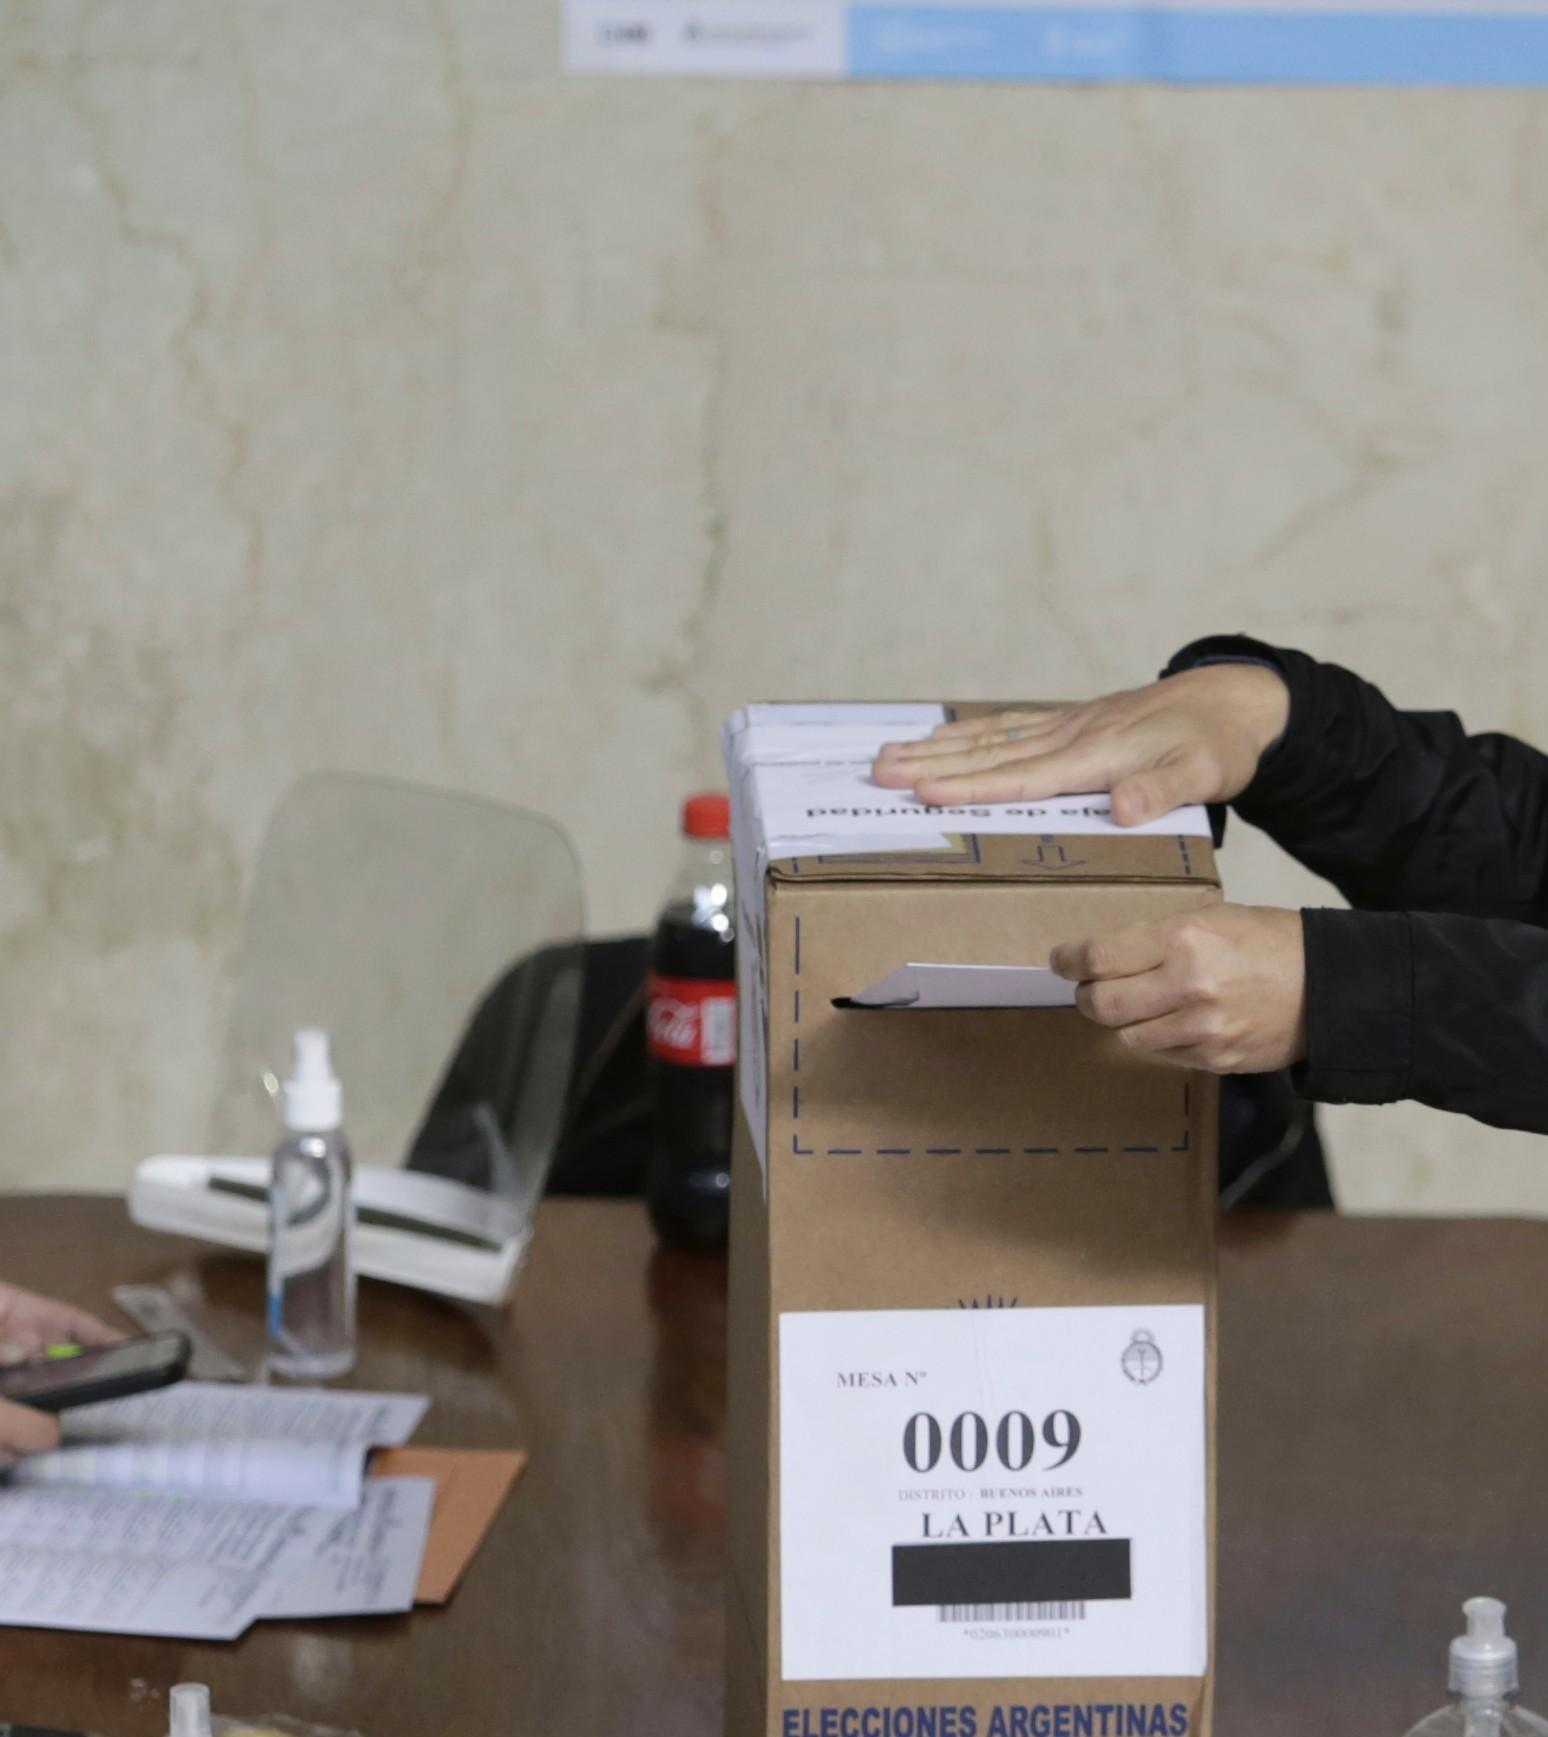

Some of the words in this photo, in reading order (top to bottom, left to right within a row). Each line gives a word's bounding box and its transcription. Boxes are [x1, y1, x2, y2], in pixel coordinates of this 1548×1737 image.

[807, 805, 991, 818] Seguridad
[1005, 807, 1047, 817] de
[1060, 807, 1112, 818] aja
[837, 1372, 897, 1388] MESA
[903, 1409, 1082, 1473] 0009
[899, 1488, 966, 1501] DISTRITO
[980, 1488, 1038, 1499] BUENOS
[1041, 1487, 1083, 1498] AIRES
[922, 1511, 970, 1538] LA
[984, 1510, 1109, 1537] PLATA
[783, 1704, 977, 1737] ELECCIONES
[988, 1703, 1188, 1737] ARGENTINAS
